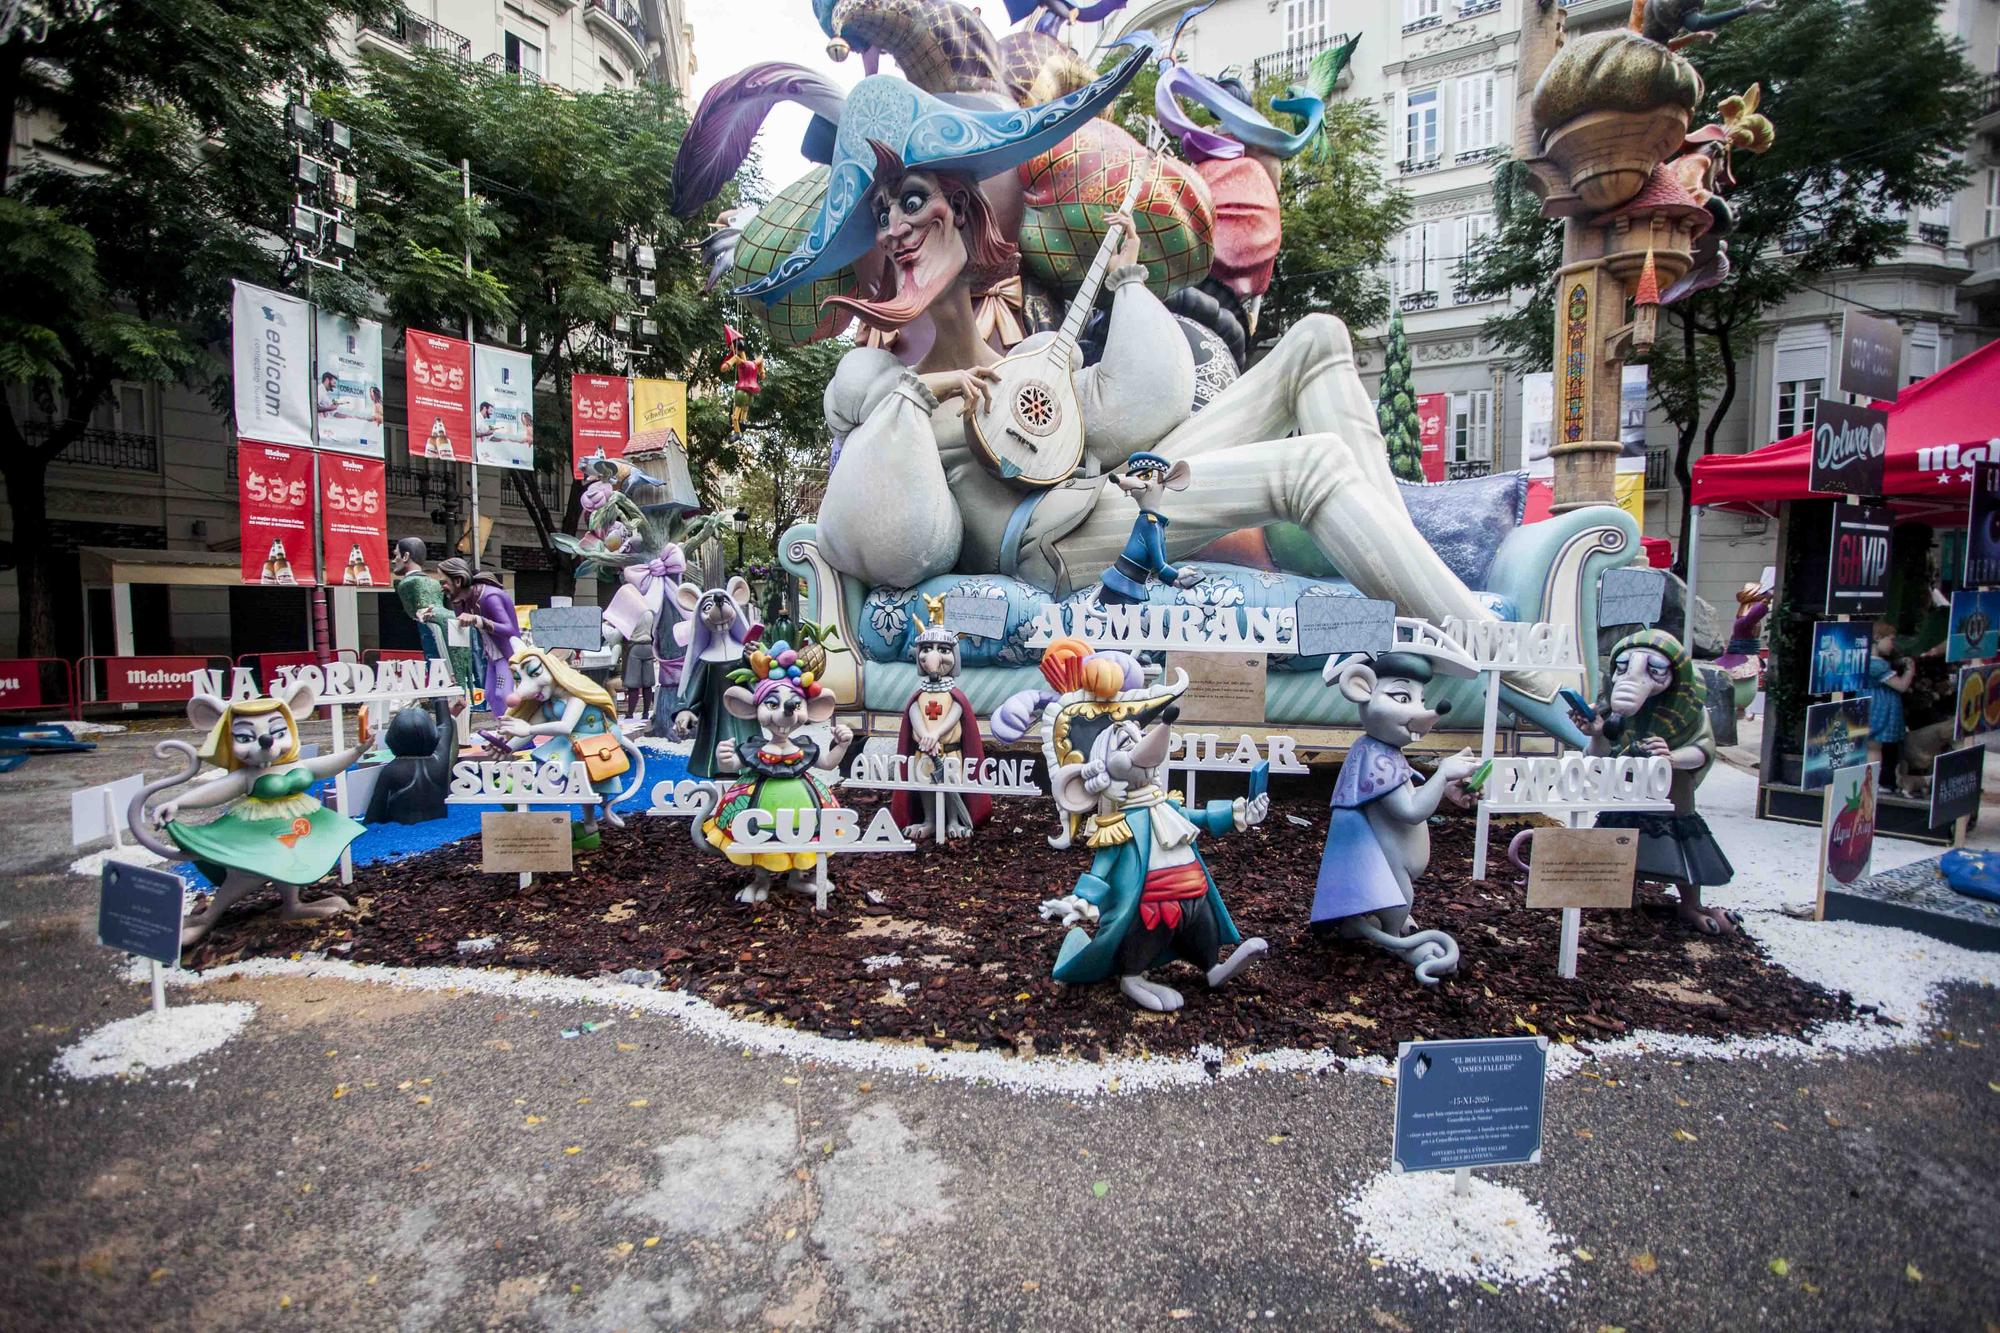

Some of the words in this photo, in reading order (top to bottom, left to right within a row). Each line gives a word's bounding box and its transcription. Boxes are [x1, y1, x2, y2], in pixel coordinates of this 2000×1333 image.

[266, 328, 286, 417] edicom
[412, 356, 465, 391] 535
[577, 395, 623, 421] 535
[264, 448, 290, 460] Mahou
[1816, 418, 1869, 471] Deluxe
[245, 469, 308, 506] 535
[327, 480, 380, 514] 535
[1838, 533, 1889, 587] GHVIP
[127, 669, 193, 685] Mahou
[192, 667, 263, 700] NA
[270, 658, 452, 698] JORDANA
[1167, 733, 1299, 769] PILAR
[450, 760, 596, 797] SUECA
[850, 753, 934, 786] ANTIC
[943, 755, 1036, 788] REGNE
[731, 807, 905, 847] CUBA
[1464, 1054, 1505, 1064] BOULEVARD
[1505, 1053, 1522, 1062] DELS
